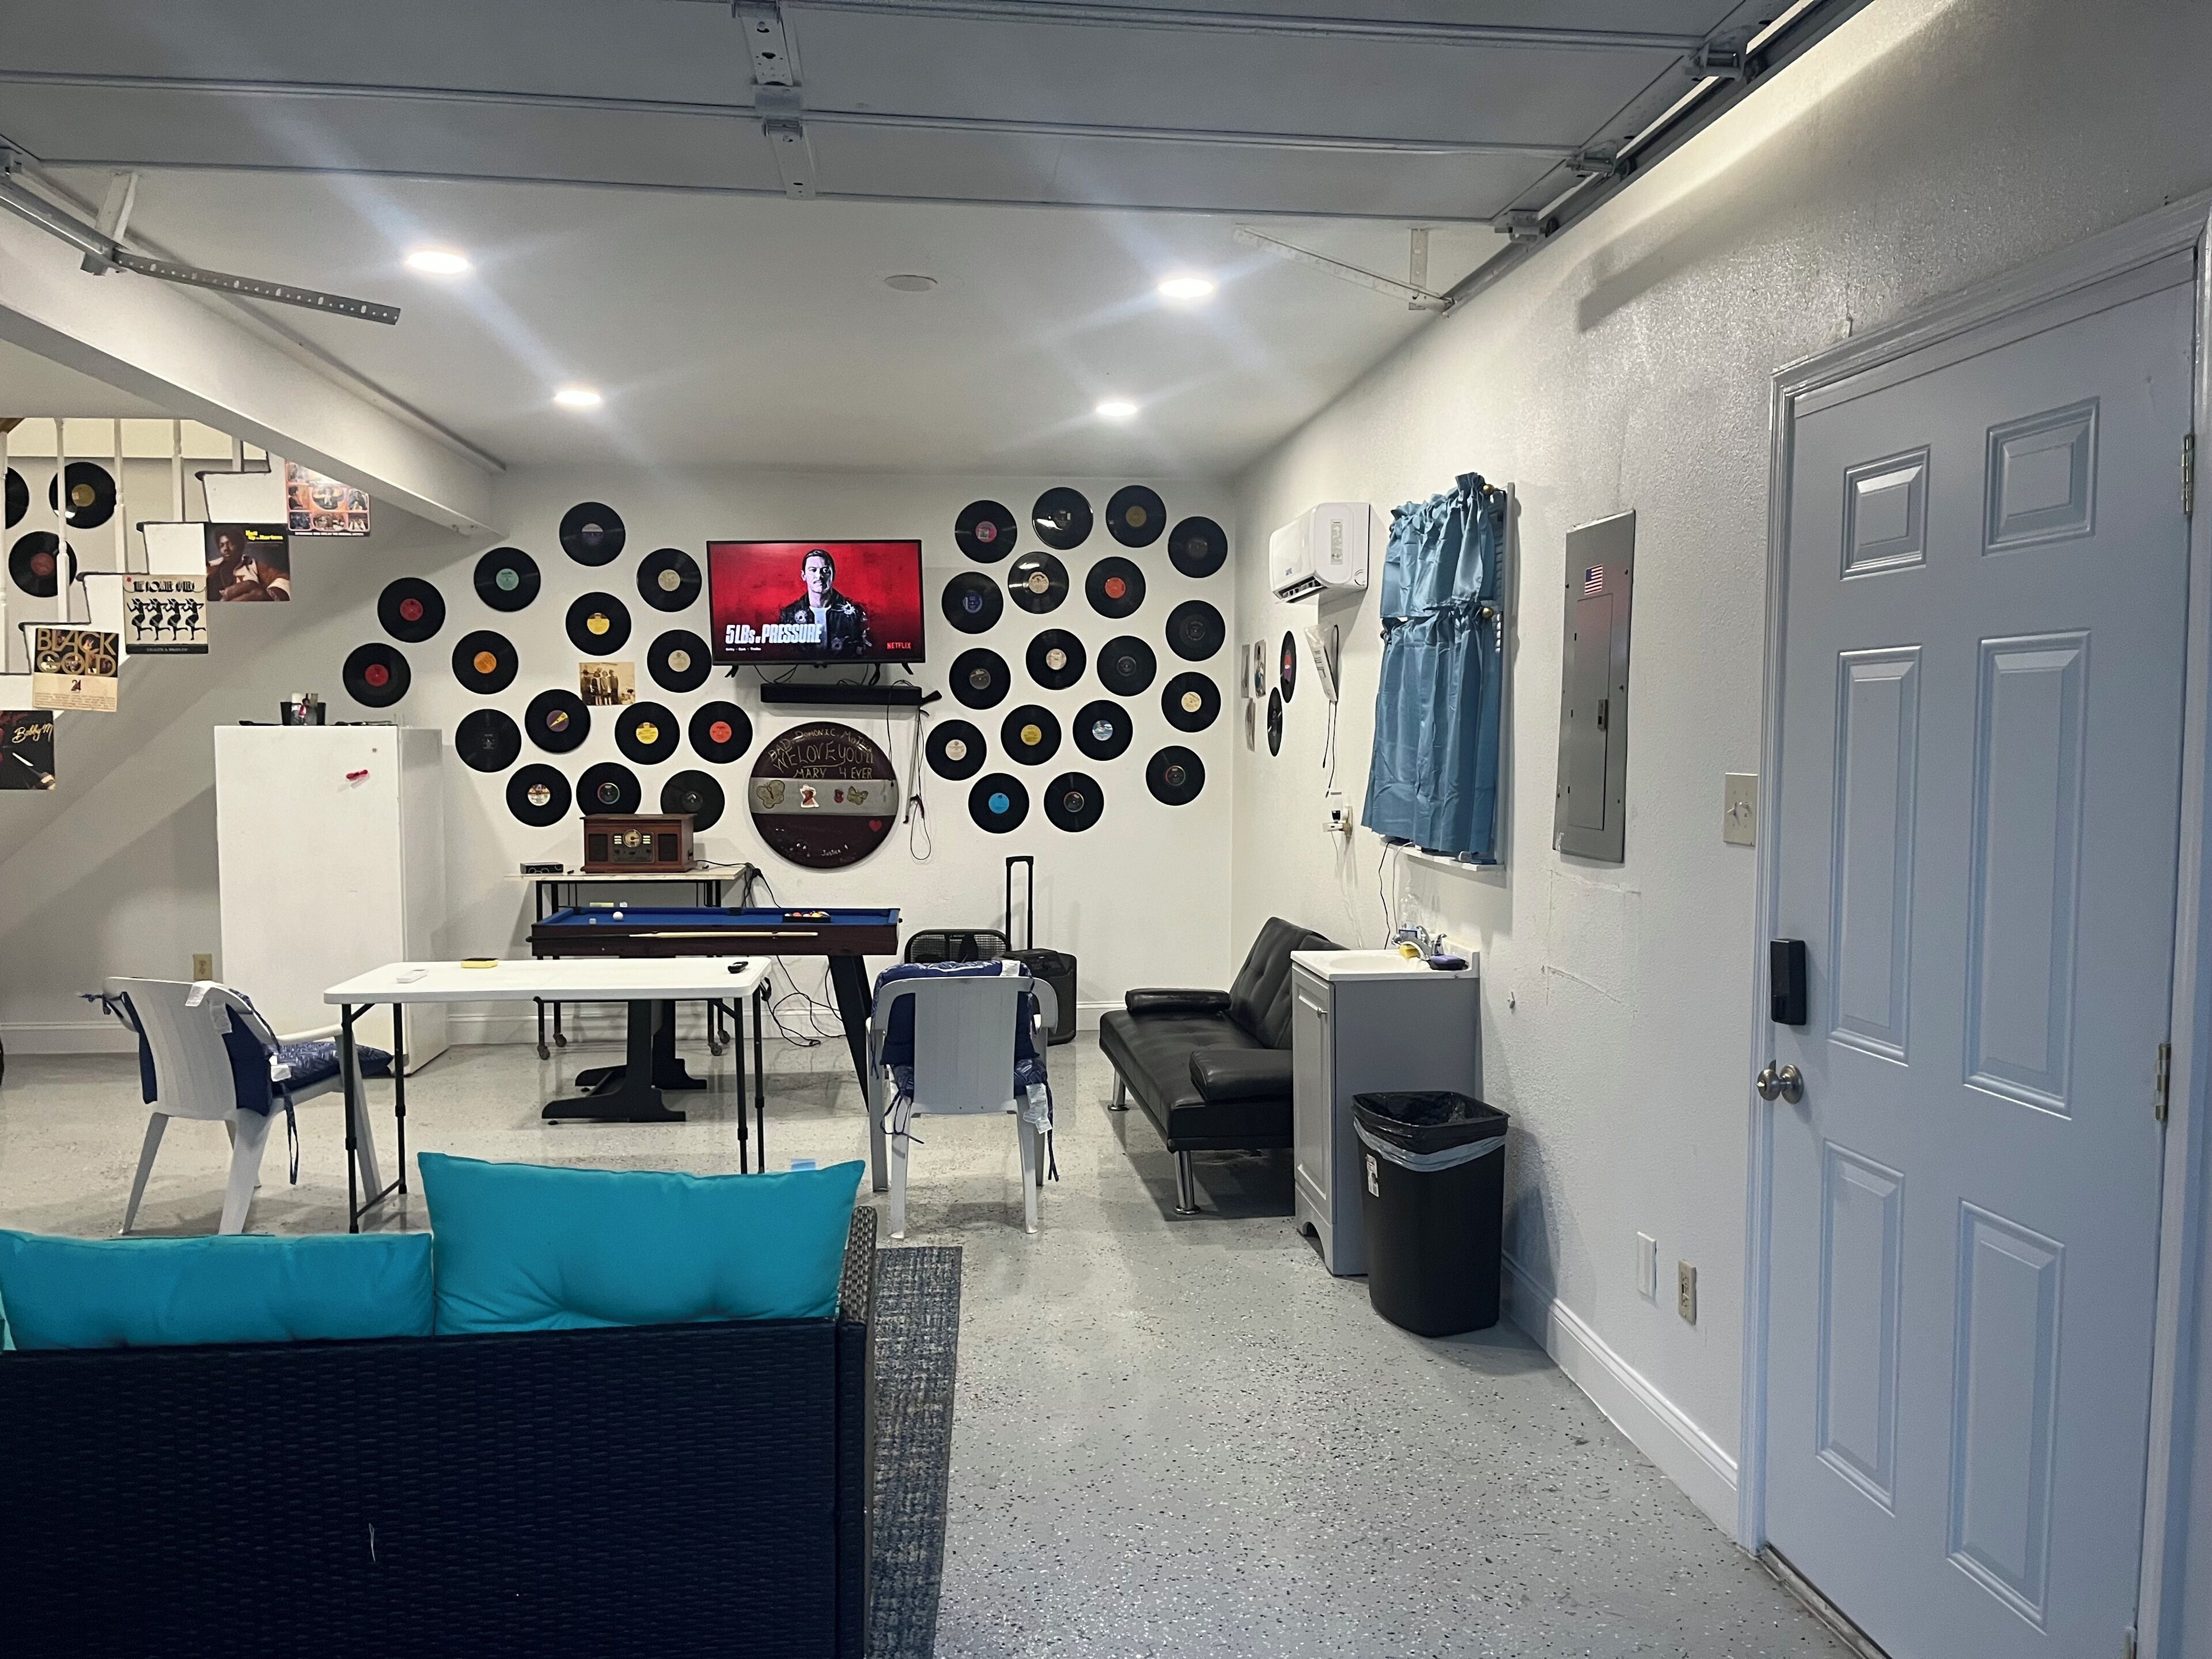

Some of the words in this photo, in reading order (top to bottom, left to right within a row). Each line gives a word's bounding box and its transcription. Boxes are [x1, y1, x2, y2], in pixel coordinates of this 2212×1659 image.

[37, 628, 116, 656] BLACK
[761, 624, 823, 643] PRESSURE
[37, 650, 116, 677] GOLD
[71, 679, 81, 691] 24
[773, 747, 797, 773] WE
[798, 741, 836, 763] LOVE
[793, 768, 827, 778] MARY
[839, 767, 846, 778] 4
[851, 767, 873, 779] EVER
